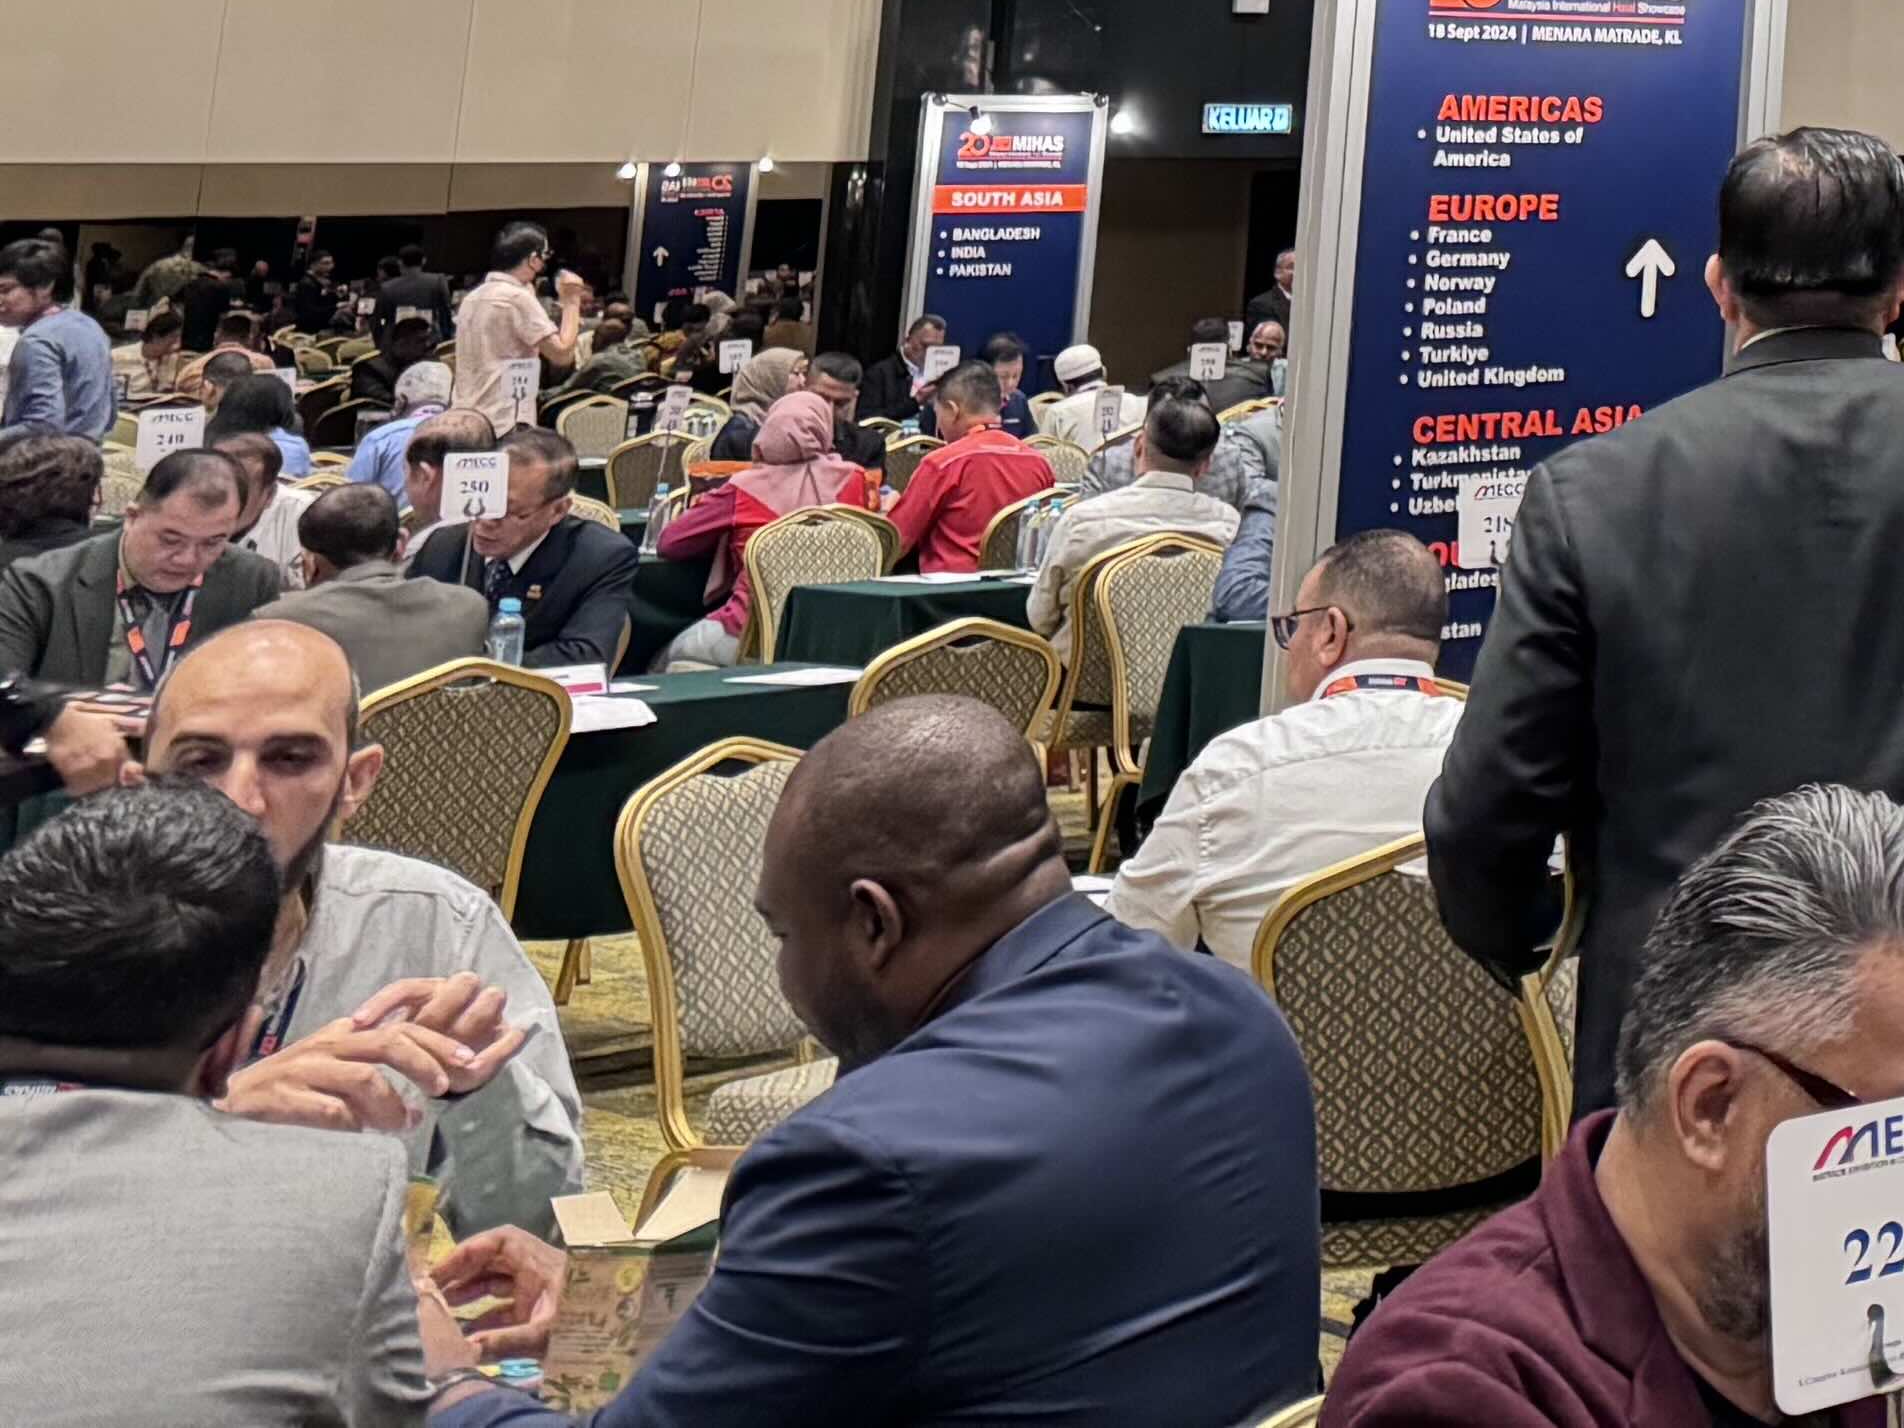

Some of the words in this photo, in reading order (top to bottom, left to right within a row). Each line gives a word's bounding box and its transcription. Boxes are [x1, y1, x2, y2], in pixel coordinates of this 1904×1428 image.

[1447, 24, 1481, 42] Sept
[1482, 24, 1517, 41] 2024
[1531, 26, 1592, 42] MENARA
[1437, 94, 1604, 123] AMERICAS
[1435, 125, 1498, 144] United
[1501, 126, 1561, 144] States
[1564, 127, 1584, 144] of
[957, 132, 990, 157] 20
[1012, 135, 1064, 152] MIHAS
[1433, 149, 1511, 167] America
[951, 191, 1016, 207] SOUTH
[1020, 191, 1064, 207] ASIA
[1428, 194, 1560, 222] EUROPE
[952, 227, 1041, 242] BANGLADESH
[1426, 226, 1493, 244] France
[951, 246, 986, 259] INDIA
[1425, 249, 1511, 270] Germany
[949, 263, 1012, 278] PAKISTAN
[1424, 273, 1496, 294] Norway
[1422, 297, 1487, 315] Poland
[1420, 321, 1484, 339] Russia
[1418, 345, 1490, 365] Turkiye
[1417, 368, 1480, 388] United
[1483, 366, 1565, 387] Kingdom
[1413, 409, 1563, 444] CENTRAL
[1411, 445, 1521, 467] Kazakhstan
